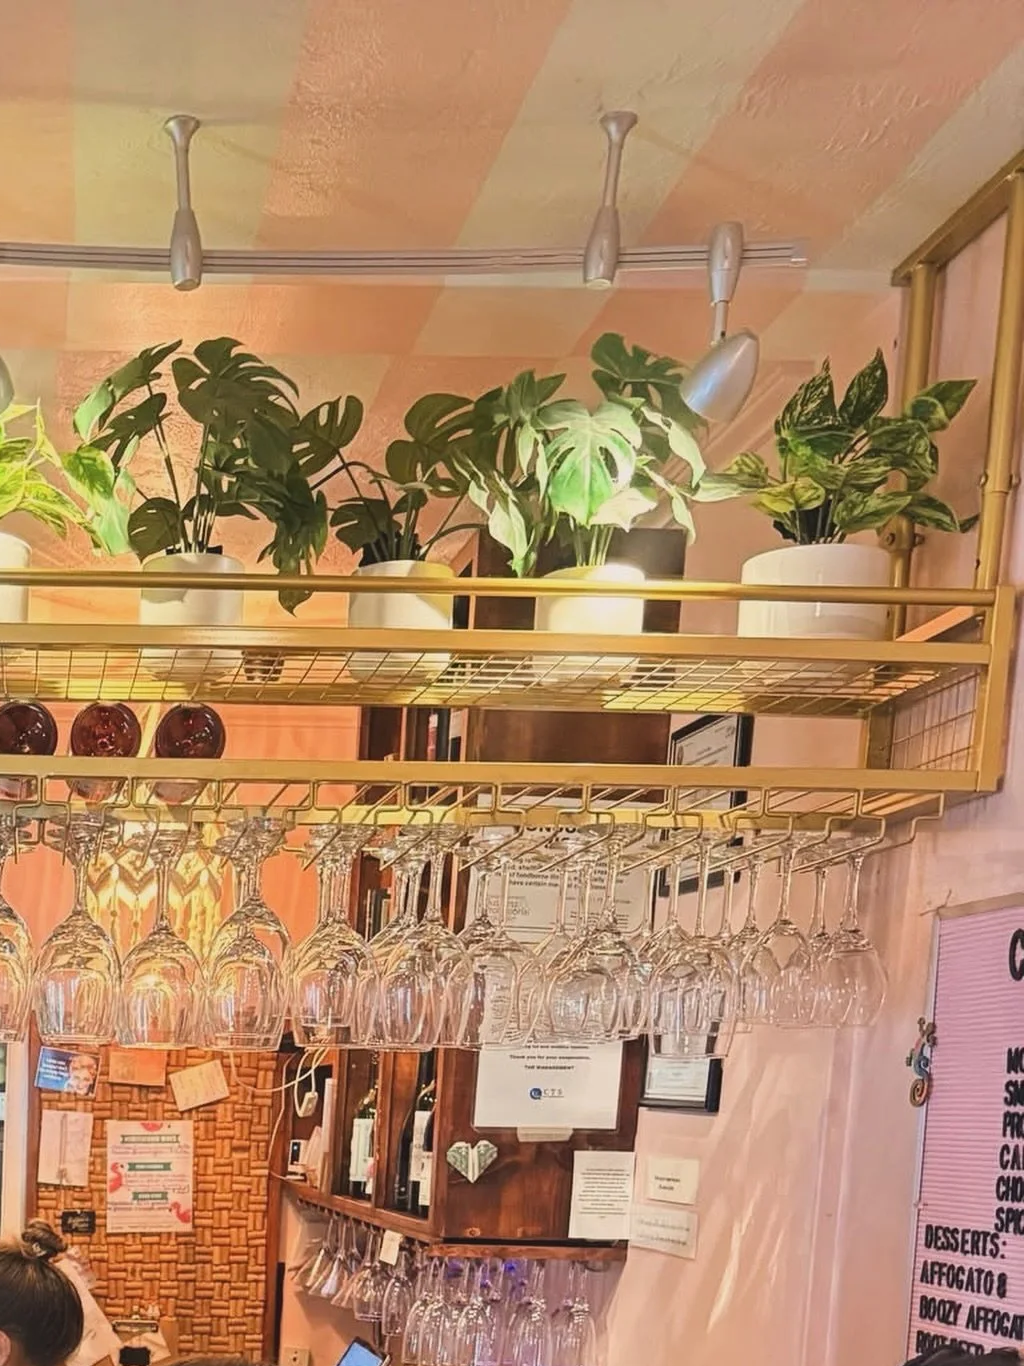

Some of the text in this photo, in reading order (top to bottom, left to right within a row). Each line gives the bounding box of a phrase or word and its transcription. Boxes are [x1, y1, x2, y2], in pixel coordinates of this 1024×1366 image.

[924, 1223, 1008, 1260] DESSERTS:
[919, 1259, 995, 1297] AFFOGATO
[918, 1294, 1024, 1341] BOOZY AFFOGAT
